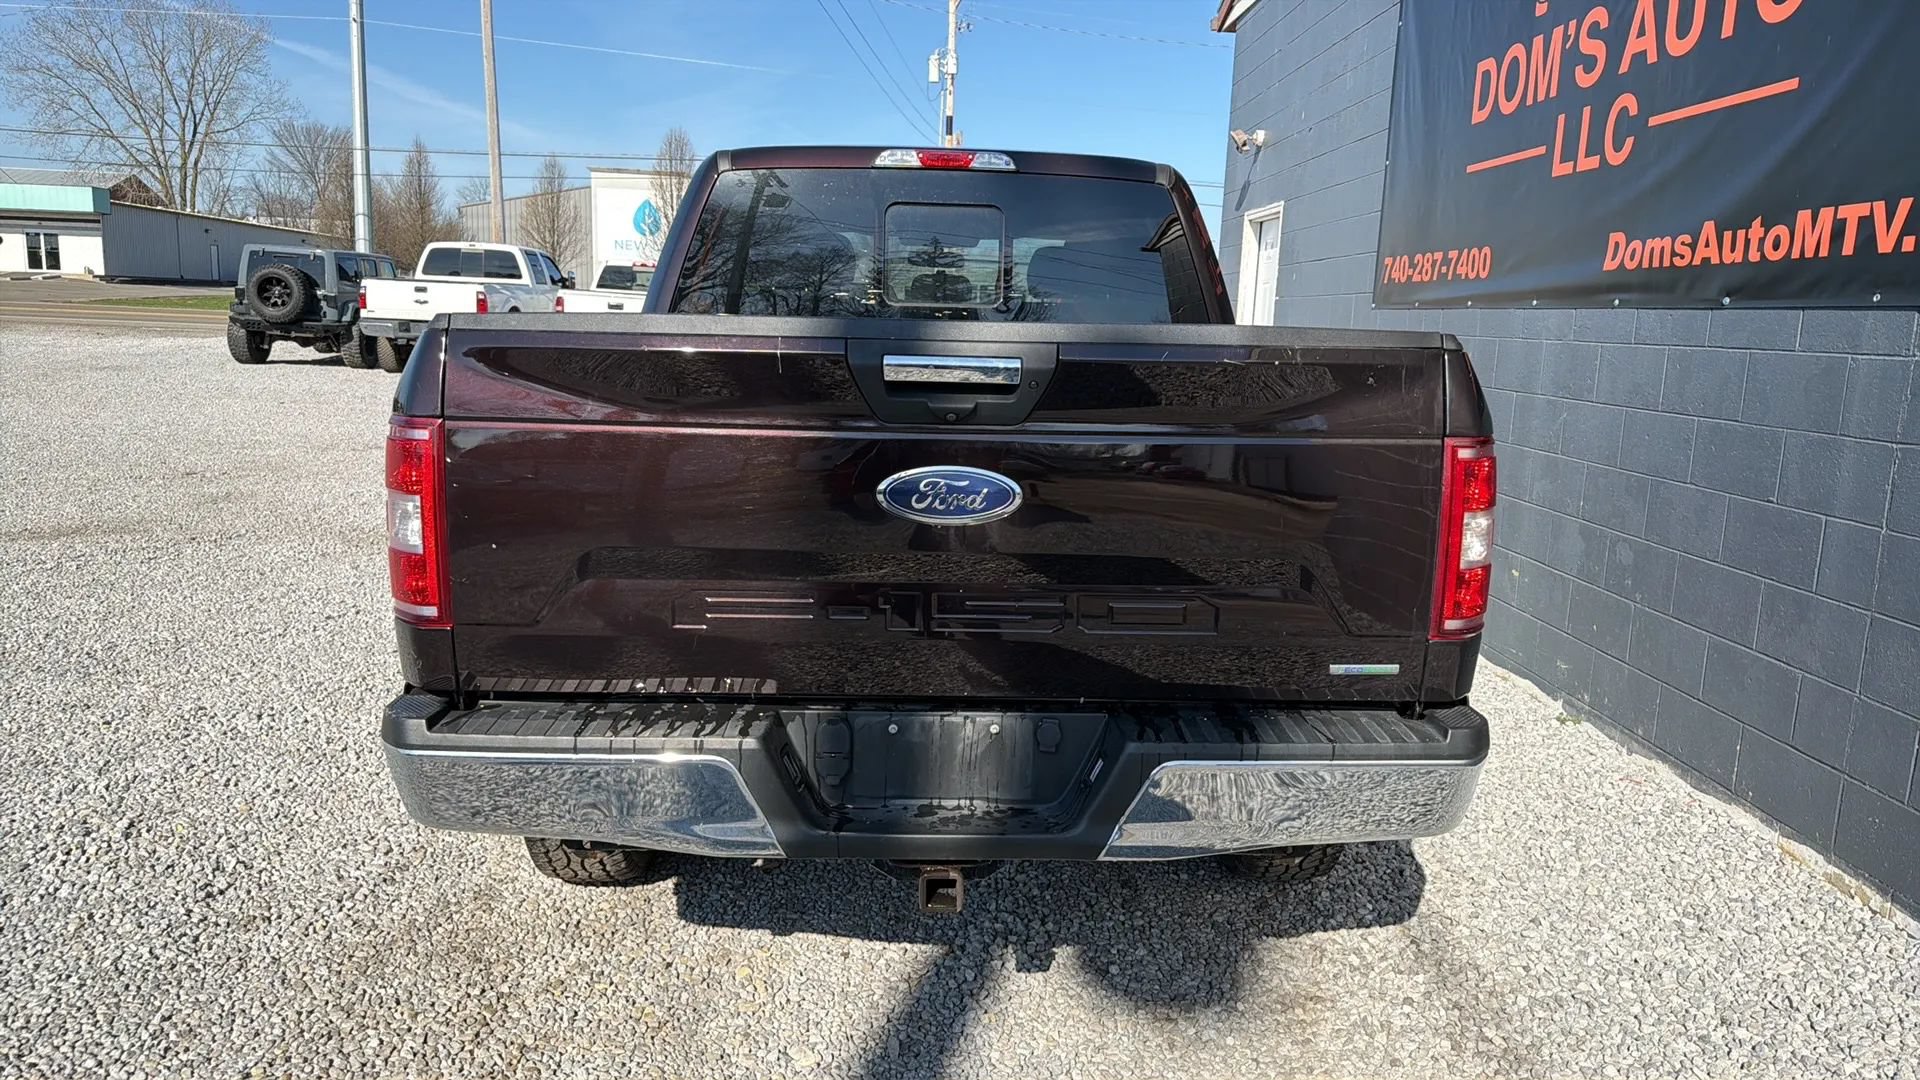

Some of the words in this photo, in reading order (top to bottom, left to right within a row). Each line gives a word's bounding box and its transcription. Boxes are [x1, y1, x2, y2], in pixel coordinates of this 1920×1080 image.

[1471, 6, 1609, 125] DOM'S
[1552, 93, 1639, 178] LLC
[1384, 247, 1491, 283] 740-287-7400
[1603, 197, 1916, 271] DomsAutoMTV.
[911, 478, 988, 510] Ford
